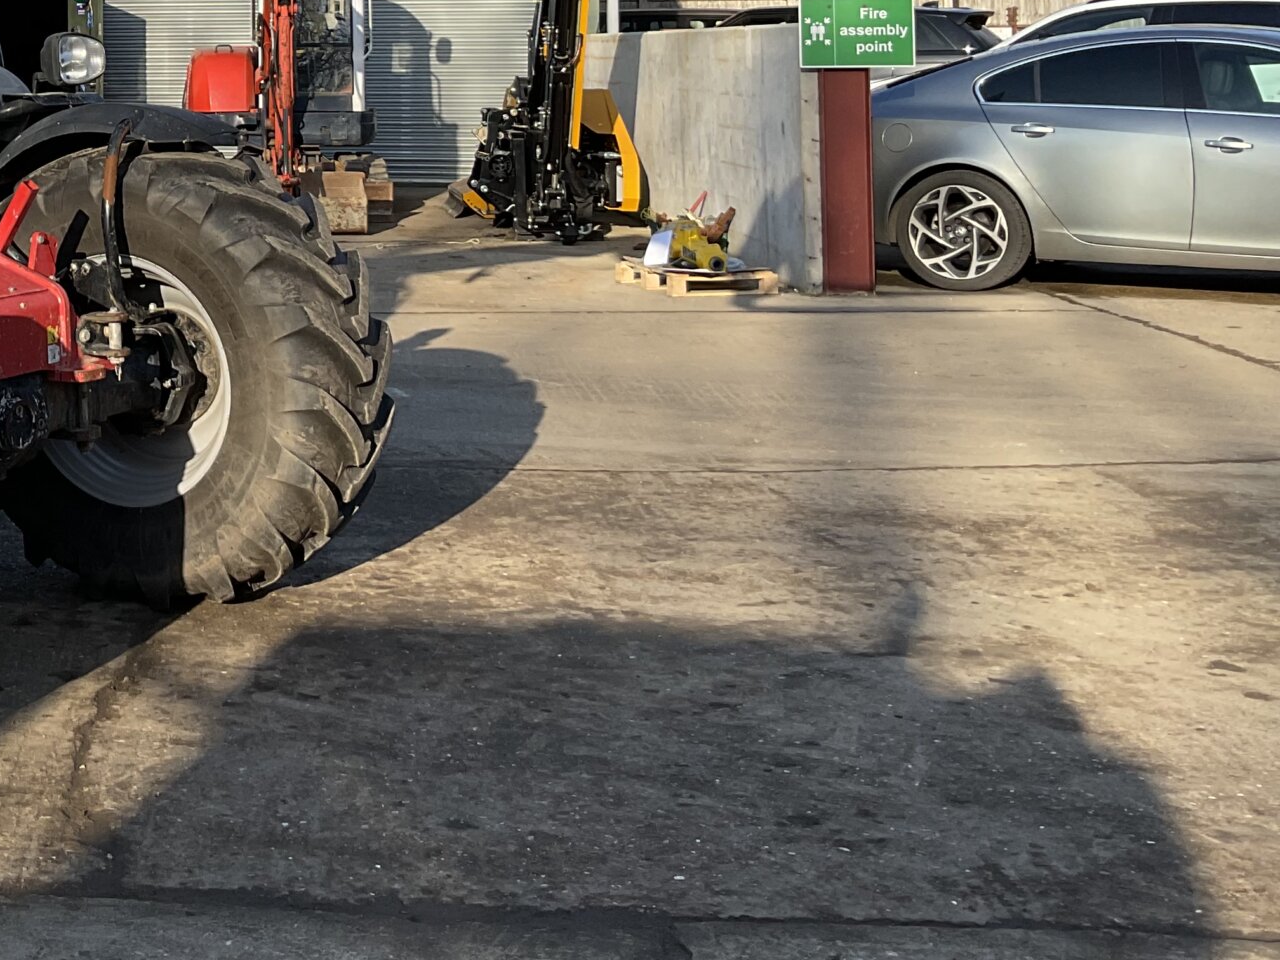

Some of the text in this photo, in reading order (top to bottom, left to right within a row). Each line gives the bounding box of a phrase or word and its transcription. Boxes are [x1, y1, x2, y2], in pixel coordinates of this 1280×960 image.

[860, 7, 888, 19] Fire
[839, 24, 908, 38] assembly
[856, 40, 893, 55] point
